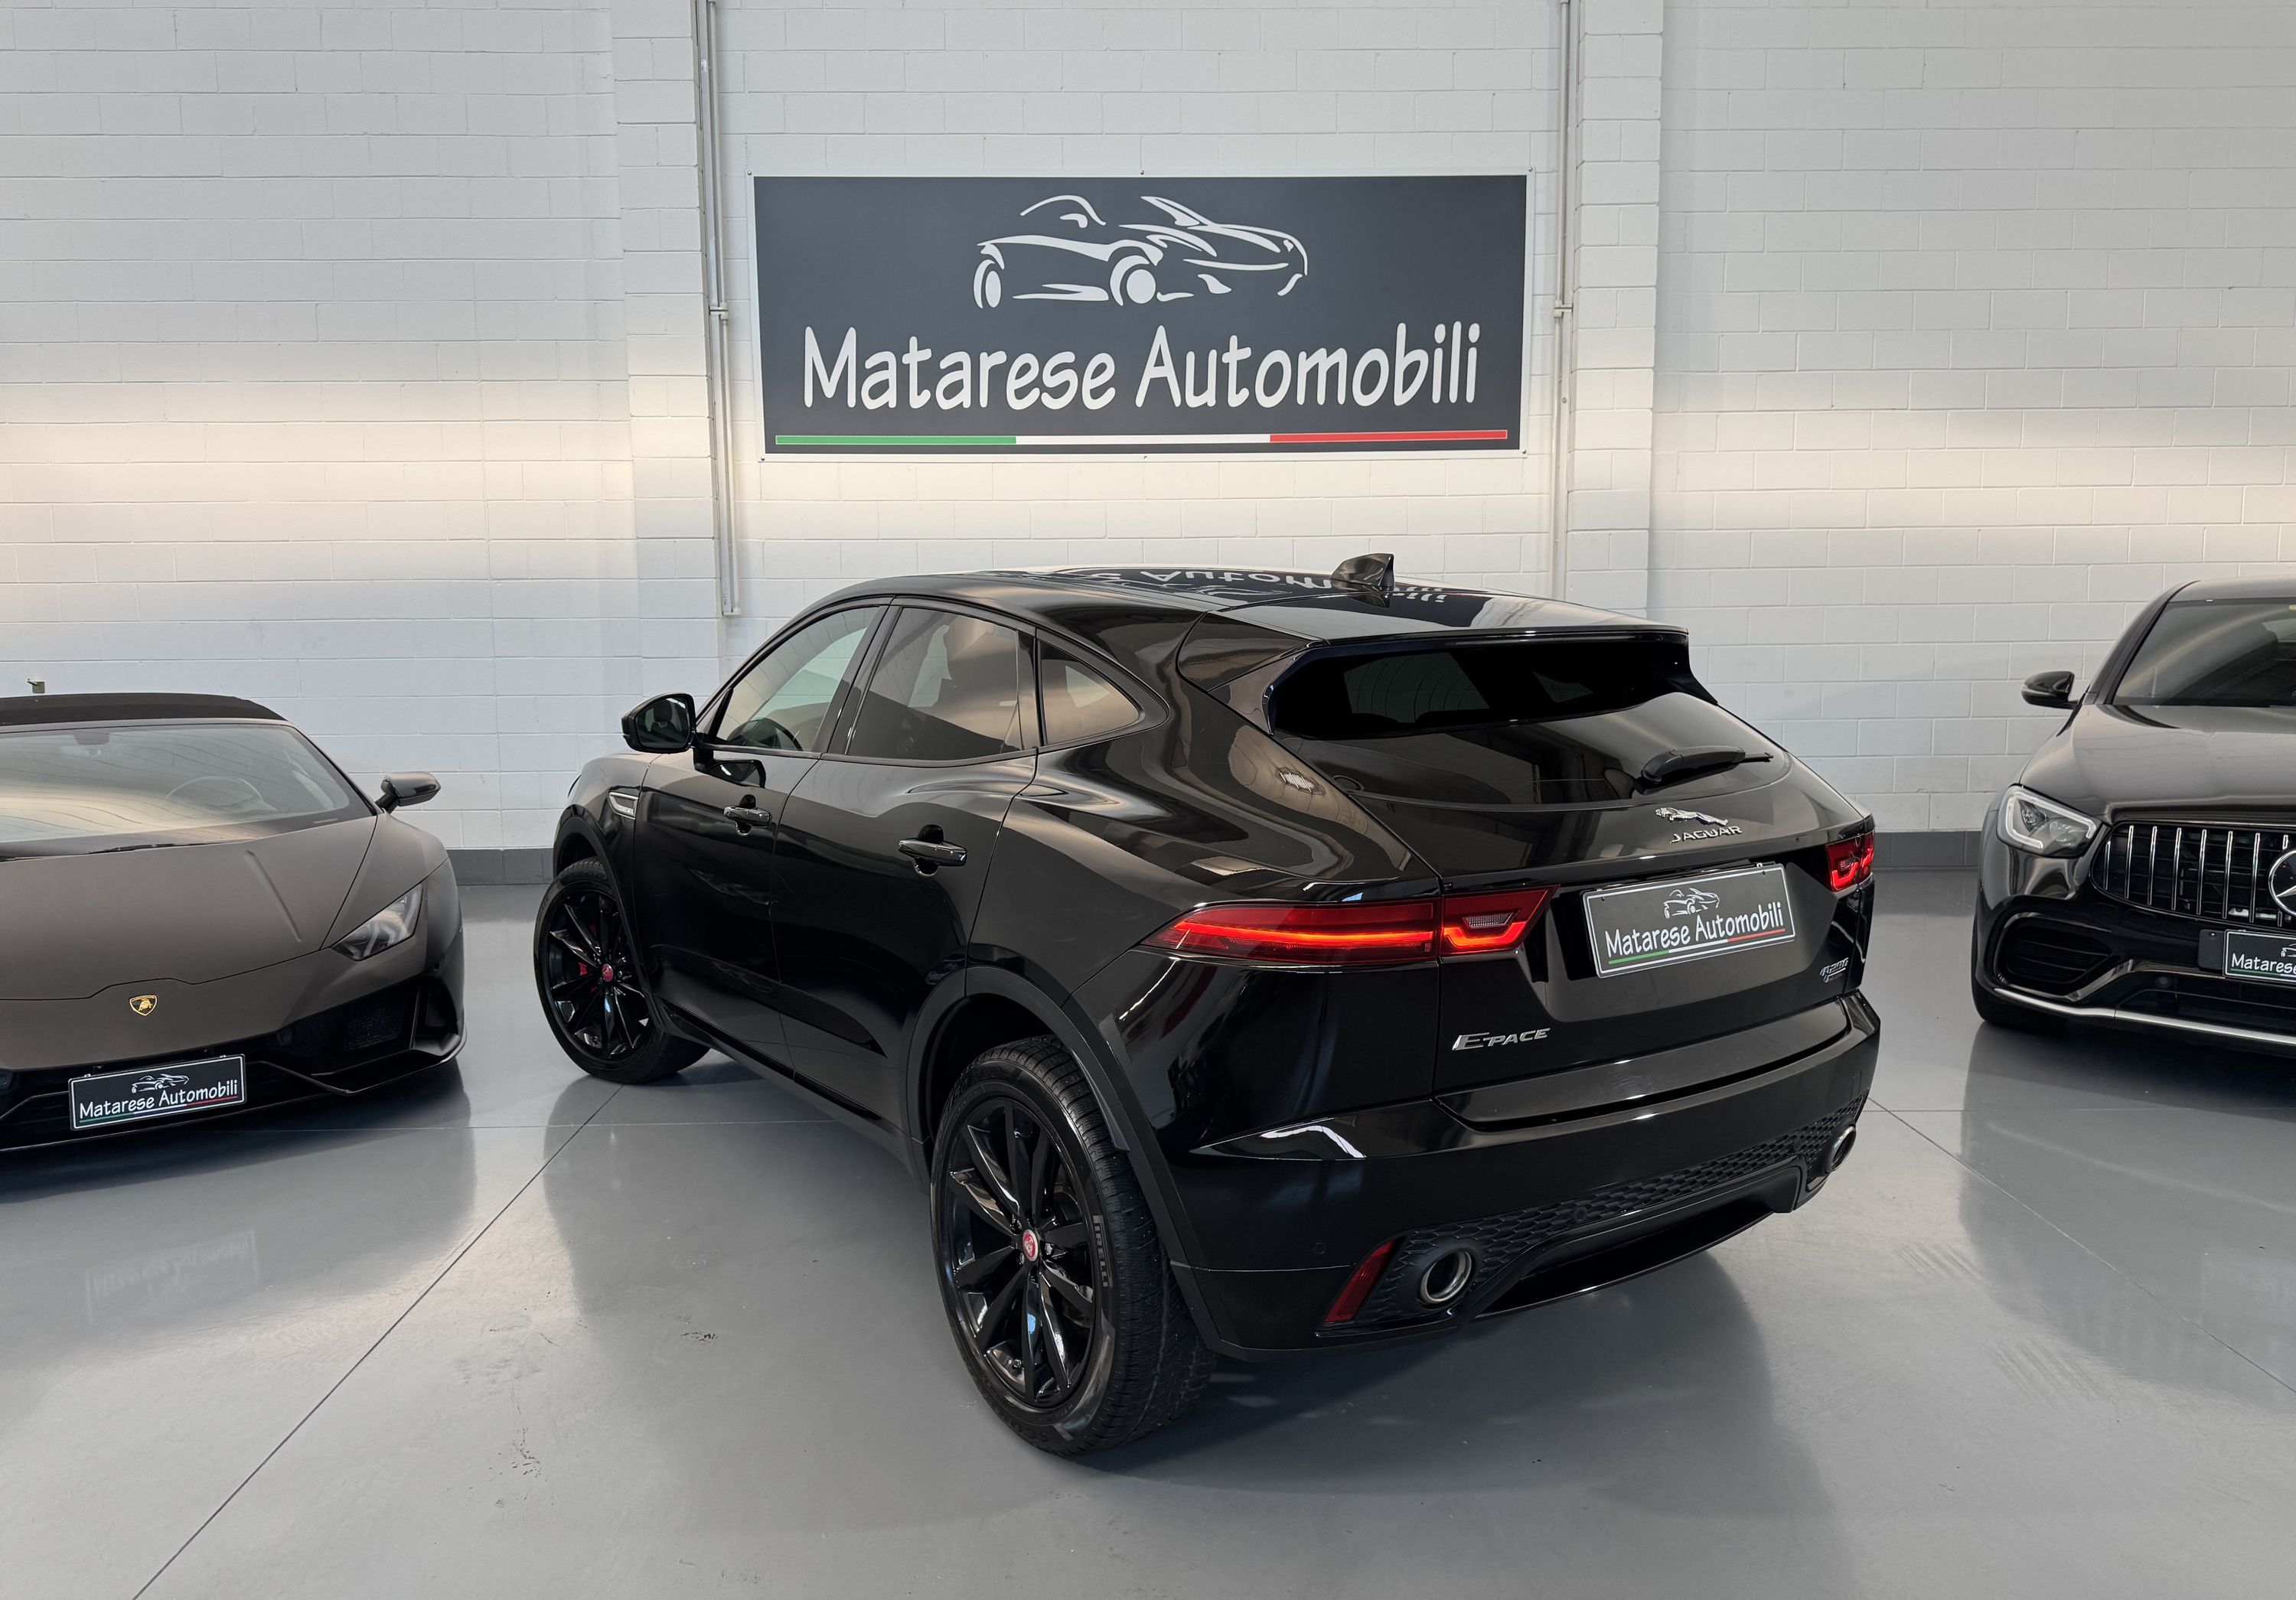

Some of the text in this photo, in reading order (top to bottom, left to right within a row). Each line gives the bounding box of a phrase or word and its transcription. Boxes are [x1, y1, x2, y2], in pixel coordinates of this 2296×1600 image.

[804, 321, 1480, 410] Matarese Automobili
[1669, 826, 1743, 844] JAGUAR
[1605, 901, 1784, 958] Matarese Automobili
[1452, 1028, 1551, 1051] E-PACE
[80, 1079, 238, 1119] Matarese Automobili
[1092, 1214, 1114, 1289] PIRELLI
